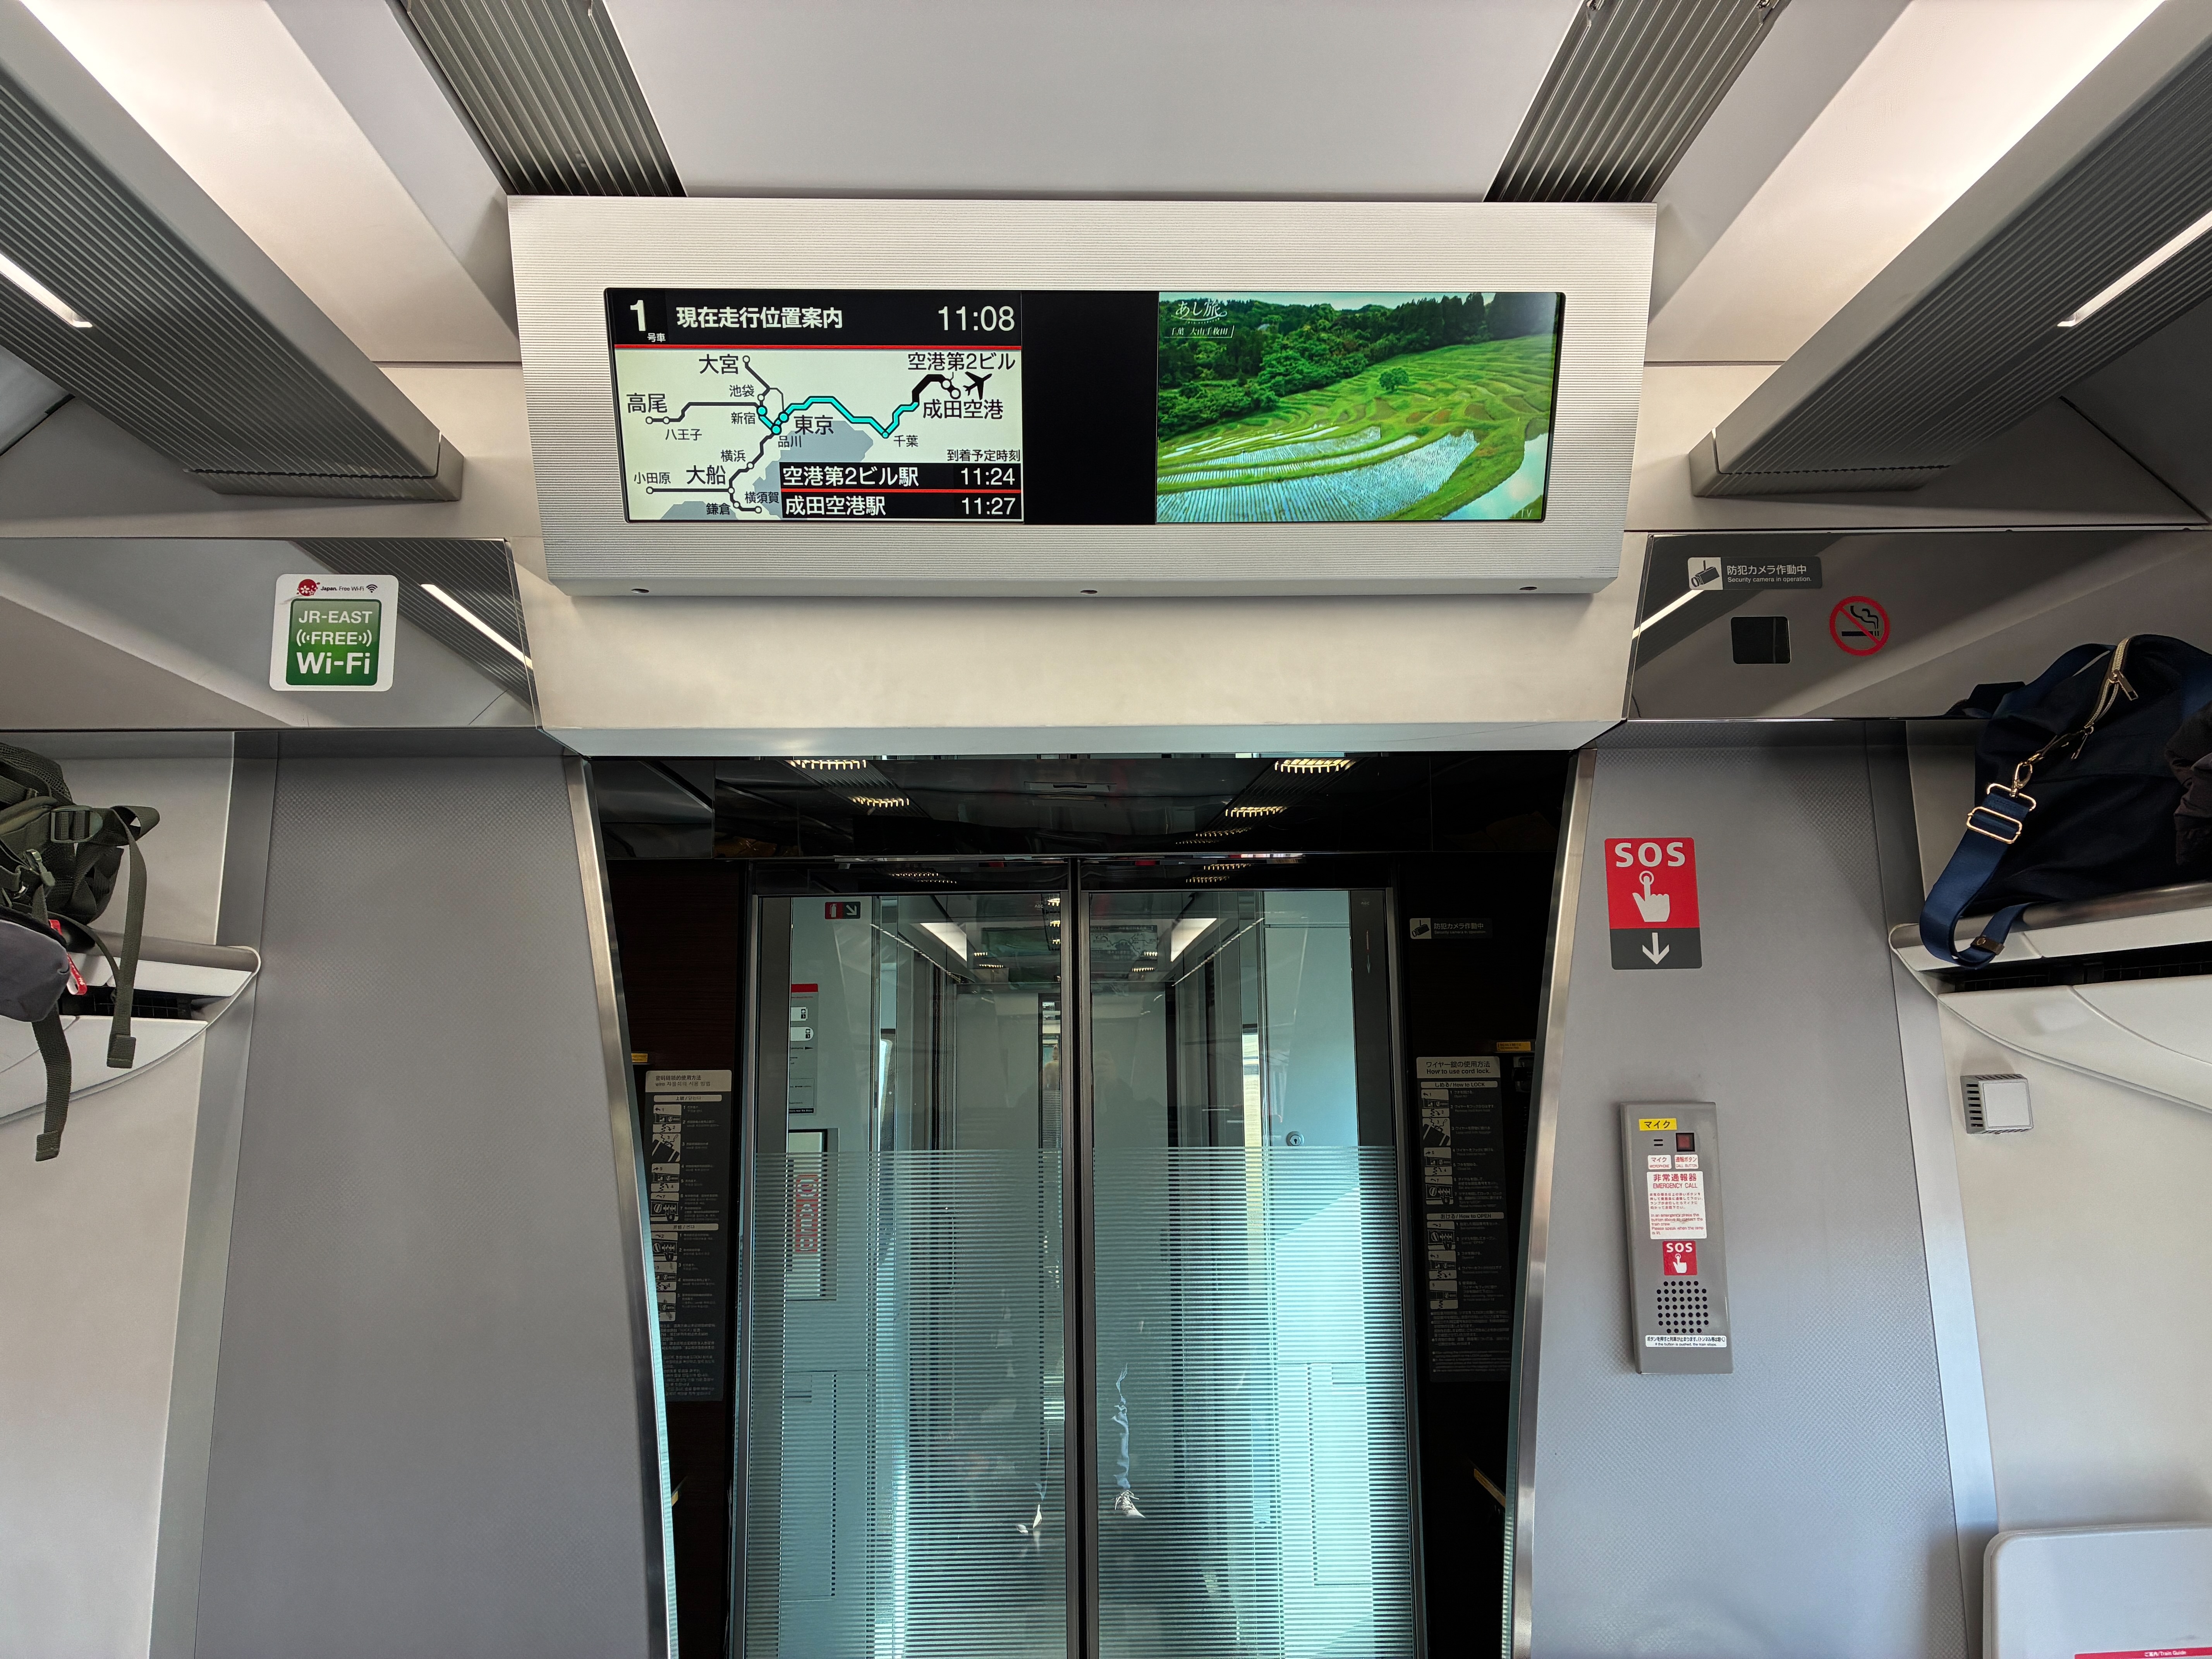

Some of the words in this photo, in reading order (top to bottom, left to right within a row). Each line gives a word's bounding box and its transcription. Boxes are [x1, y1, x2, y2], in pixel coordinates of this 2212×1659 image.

[630, 300, 646, 331] 1
[677, 308, 842, 328] 現在走行位置案内
[938, 306, 1015, 331] 11:08
[647, 333, 665, 342] 号車
[699, 355, 738, 374] 大宮
[908, 353, 1015, 370] 空港第2ビル
[730, 385, 754, 397] 池袋
[627, 394, 667, 413] 高尾
[923, 400, 1003, 419] 成田空港
[732, 413, 756, 424] 新宿
[795, 416, 834, 434] 東京
[665, 429, 702, 441] 八王子
[894, 435, 918, 447] 千葉
[778, 436, 802, 448] 品川
[721, 450, 746, 462] 横浜
[947, 450, 1020, 461] 到着予定時刻
[634, 472, 670, 484] 小田原
[687, 466, 726, 486] 大船
[783, 468, 919, 487] 空港第2ビル駅
[961, 469, 1015, 485] 11:24
[745, 493, 779, 504] 横須賀
[706, 504, 730, 515] 鎌倉
[786, 498, 885, 516] 成田空港駅
[961, 499, 1013, 515] 11:27
[1727, 565, 1807, 575] 防犯カメラ作動中
[299, 611, 373, 623] JR-EAST
[311, 632, 358, 644] FREE
[297, 652, 370, 674] Wi-Fi
[1615, 842, 1685, 867] SOS
[1644, 1120, 1670, 1129] マイク
[1653, 1173, 1697, 1182] 非常通報器
[1666, 1243, 1693, 1252] SOS
